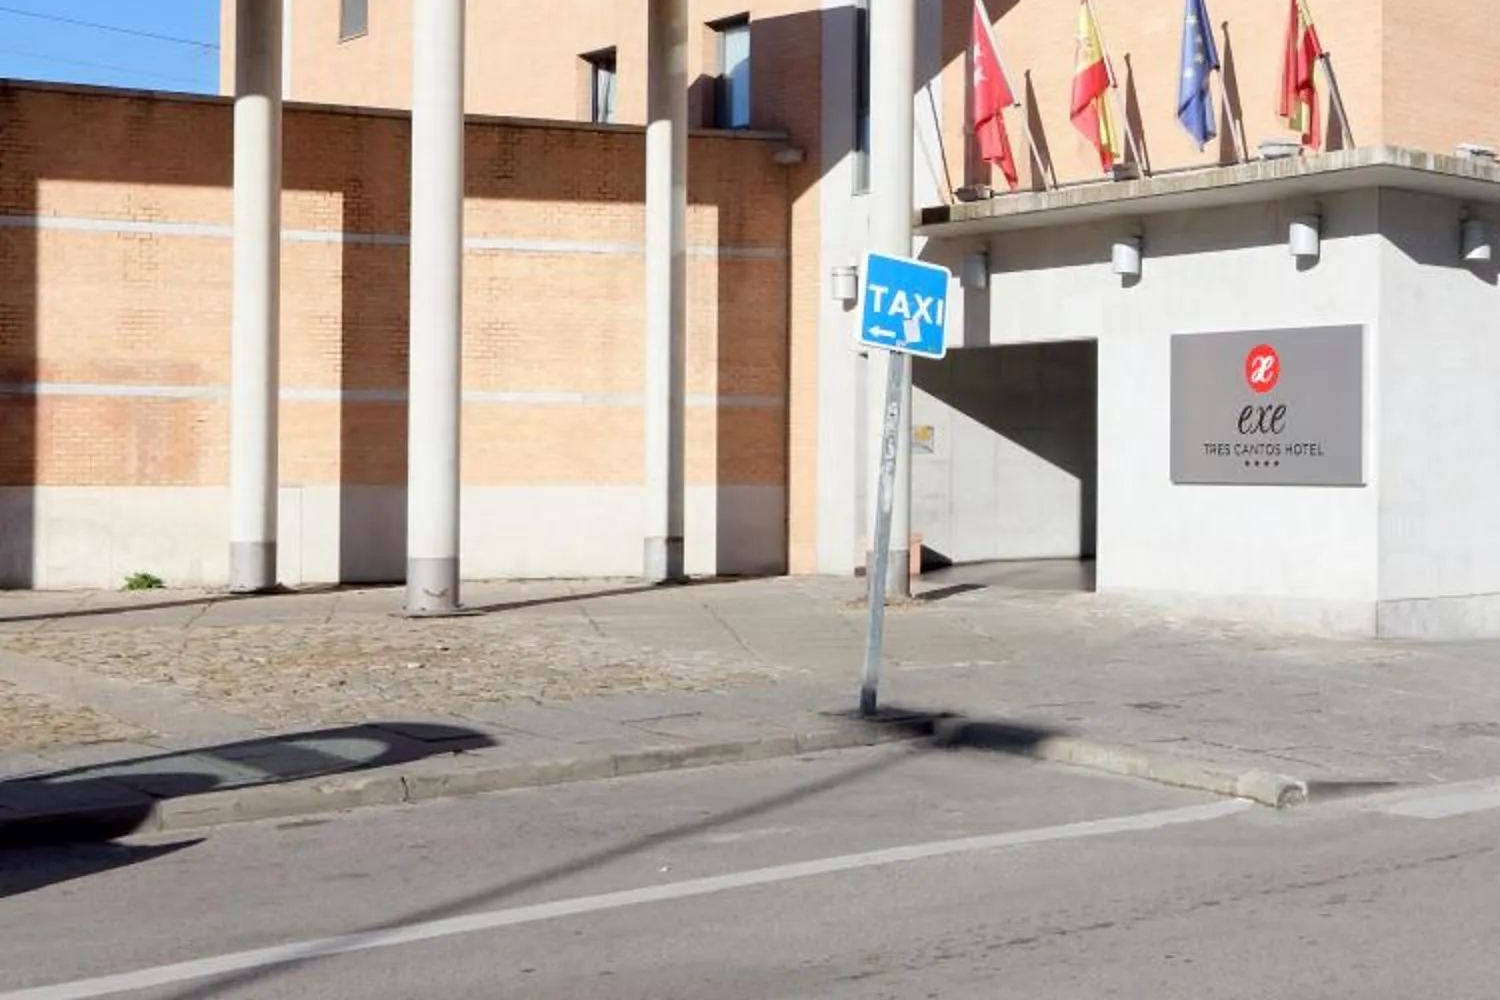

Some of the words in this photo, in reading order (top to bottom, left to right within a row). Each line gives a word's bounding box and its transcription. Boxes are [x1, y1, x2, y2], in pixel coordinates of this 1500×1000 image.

[868, 283, 944, 326] TAXI
[1238, 404, 1287, 435] exe
[1203, 443, 1231, 456] TRES
[1233, 443, 1281, 456] CANTOS
[1285, 443, 1325, 456] HOTEL
